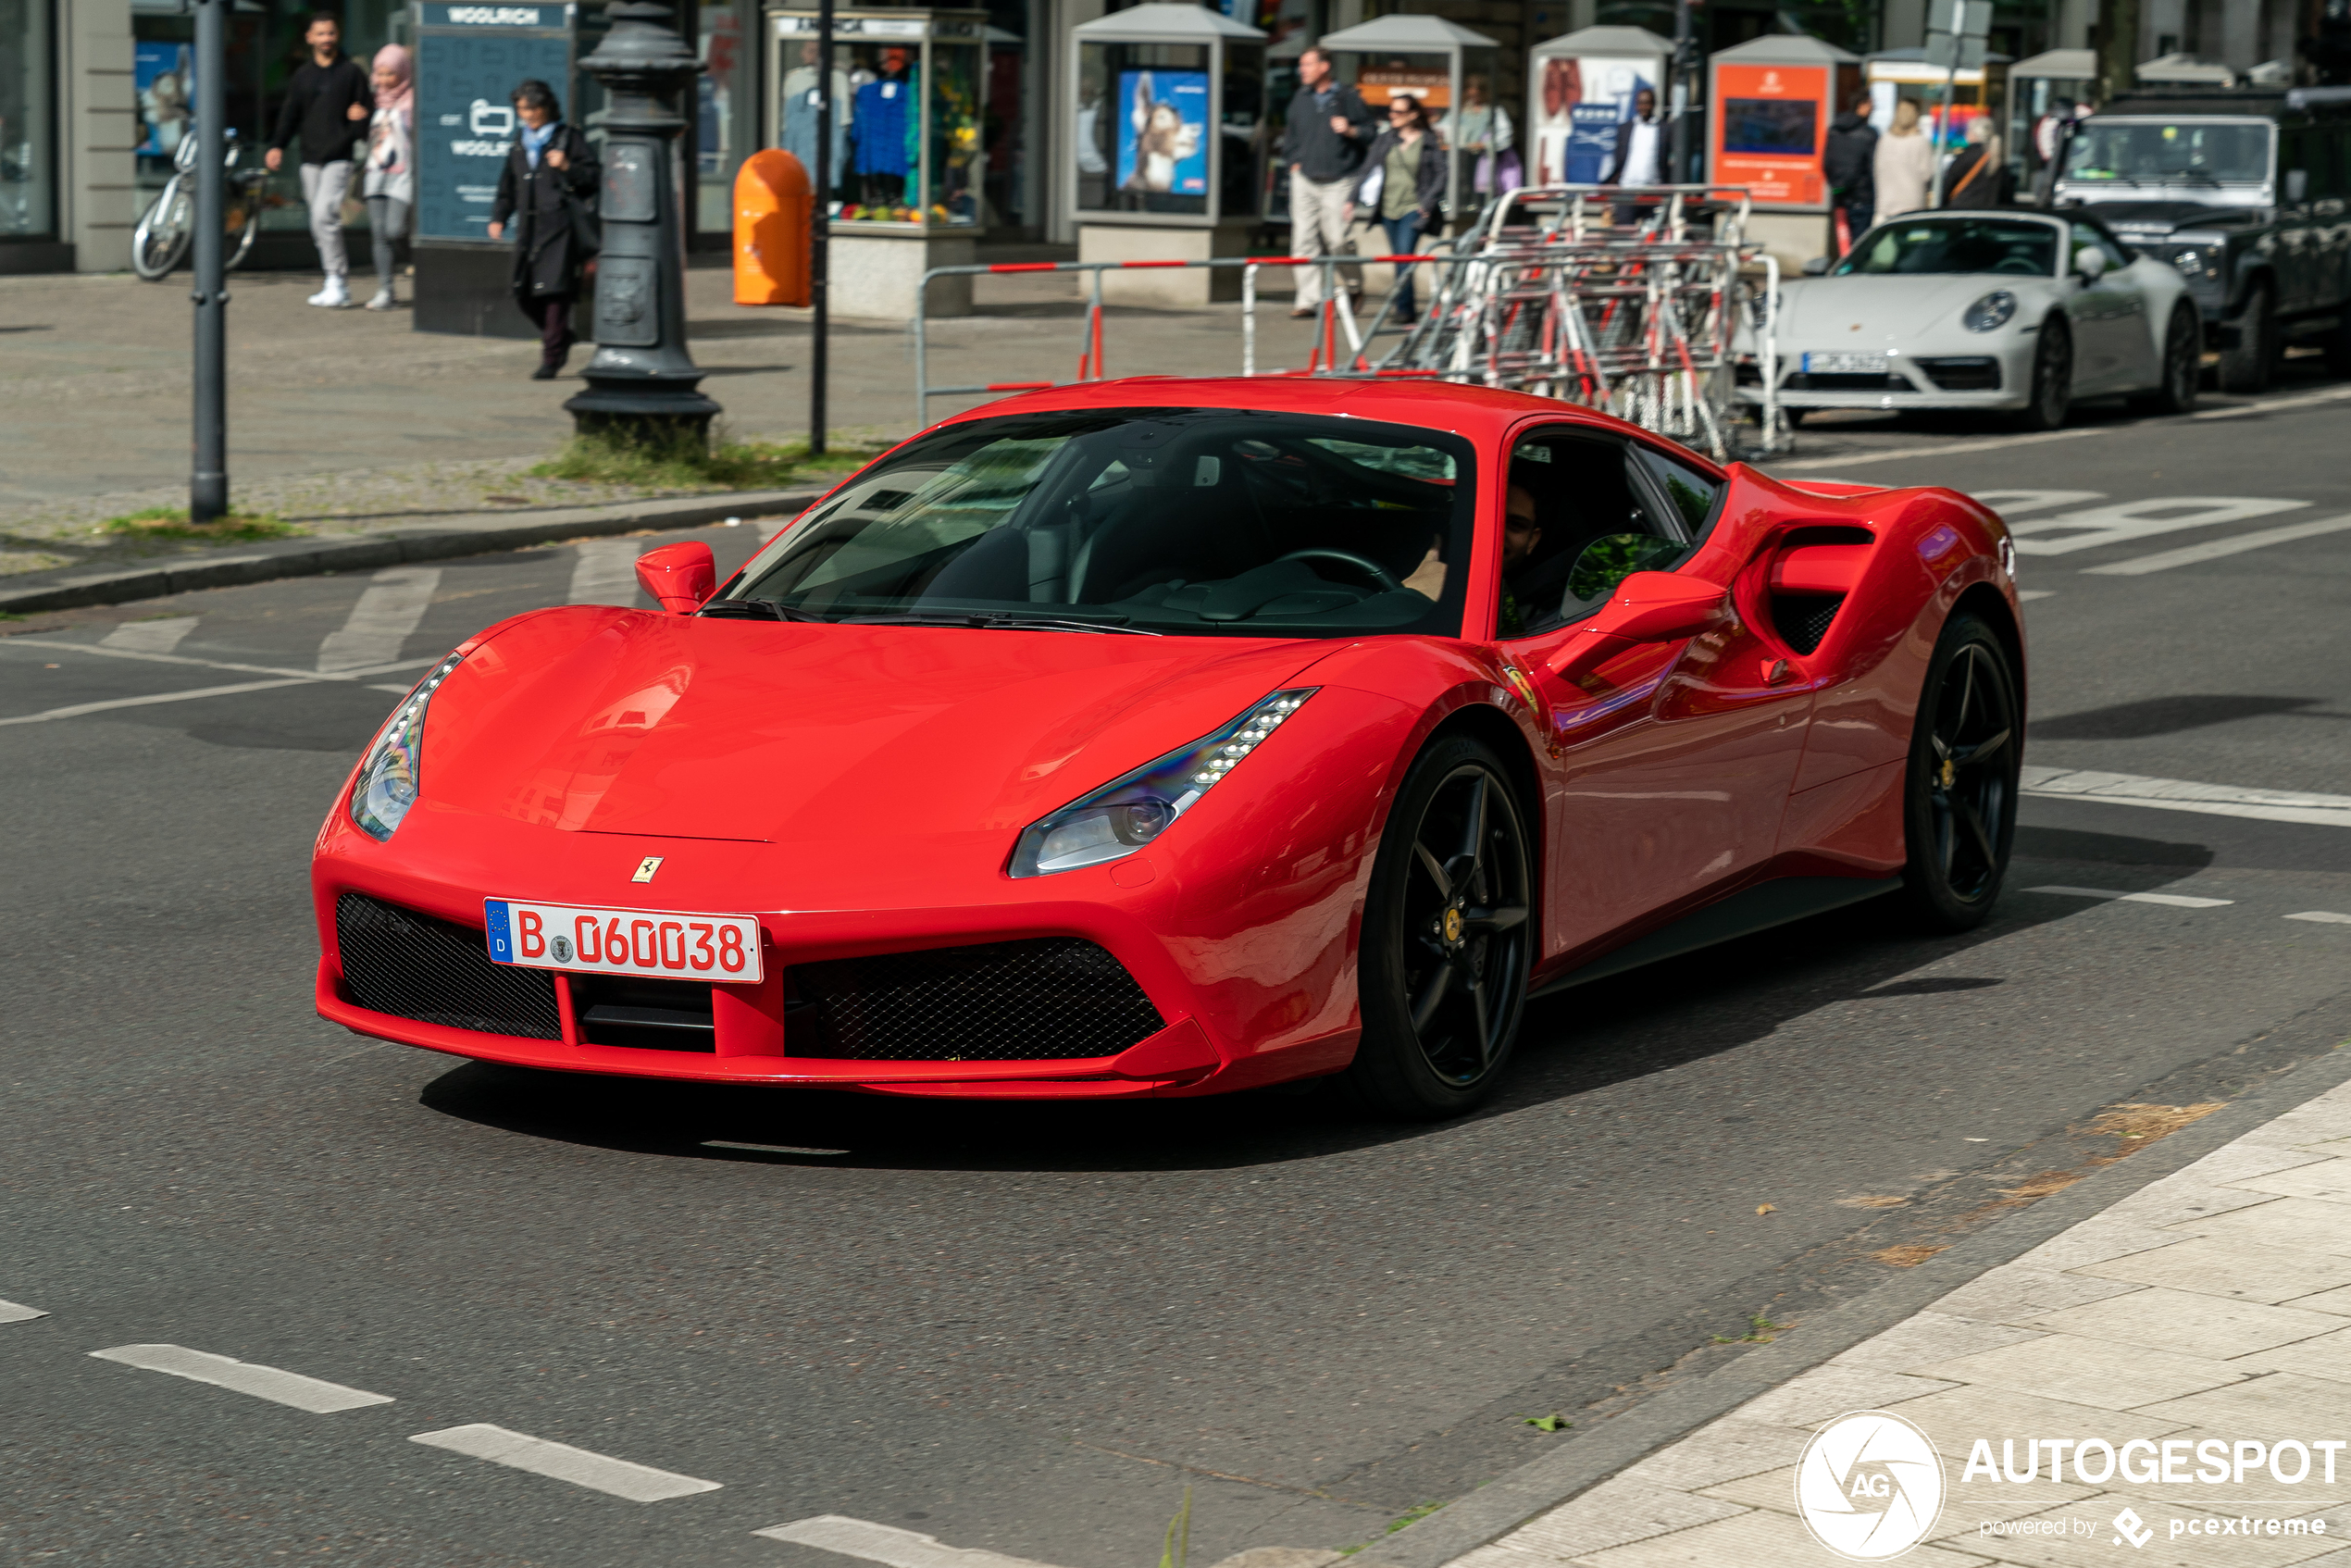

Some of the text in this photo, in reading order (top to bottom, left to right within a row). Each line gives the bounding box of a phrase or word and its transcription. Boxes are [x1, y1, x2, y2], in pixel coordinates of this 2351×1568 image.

[447, 6, 539, 25] WOOLRICH
[496, 939, 505, 952] D
[518, 910, 545, 958] B
[574, 915, 746, 973] 060038
